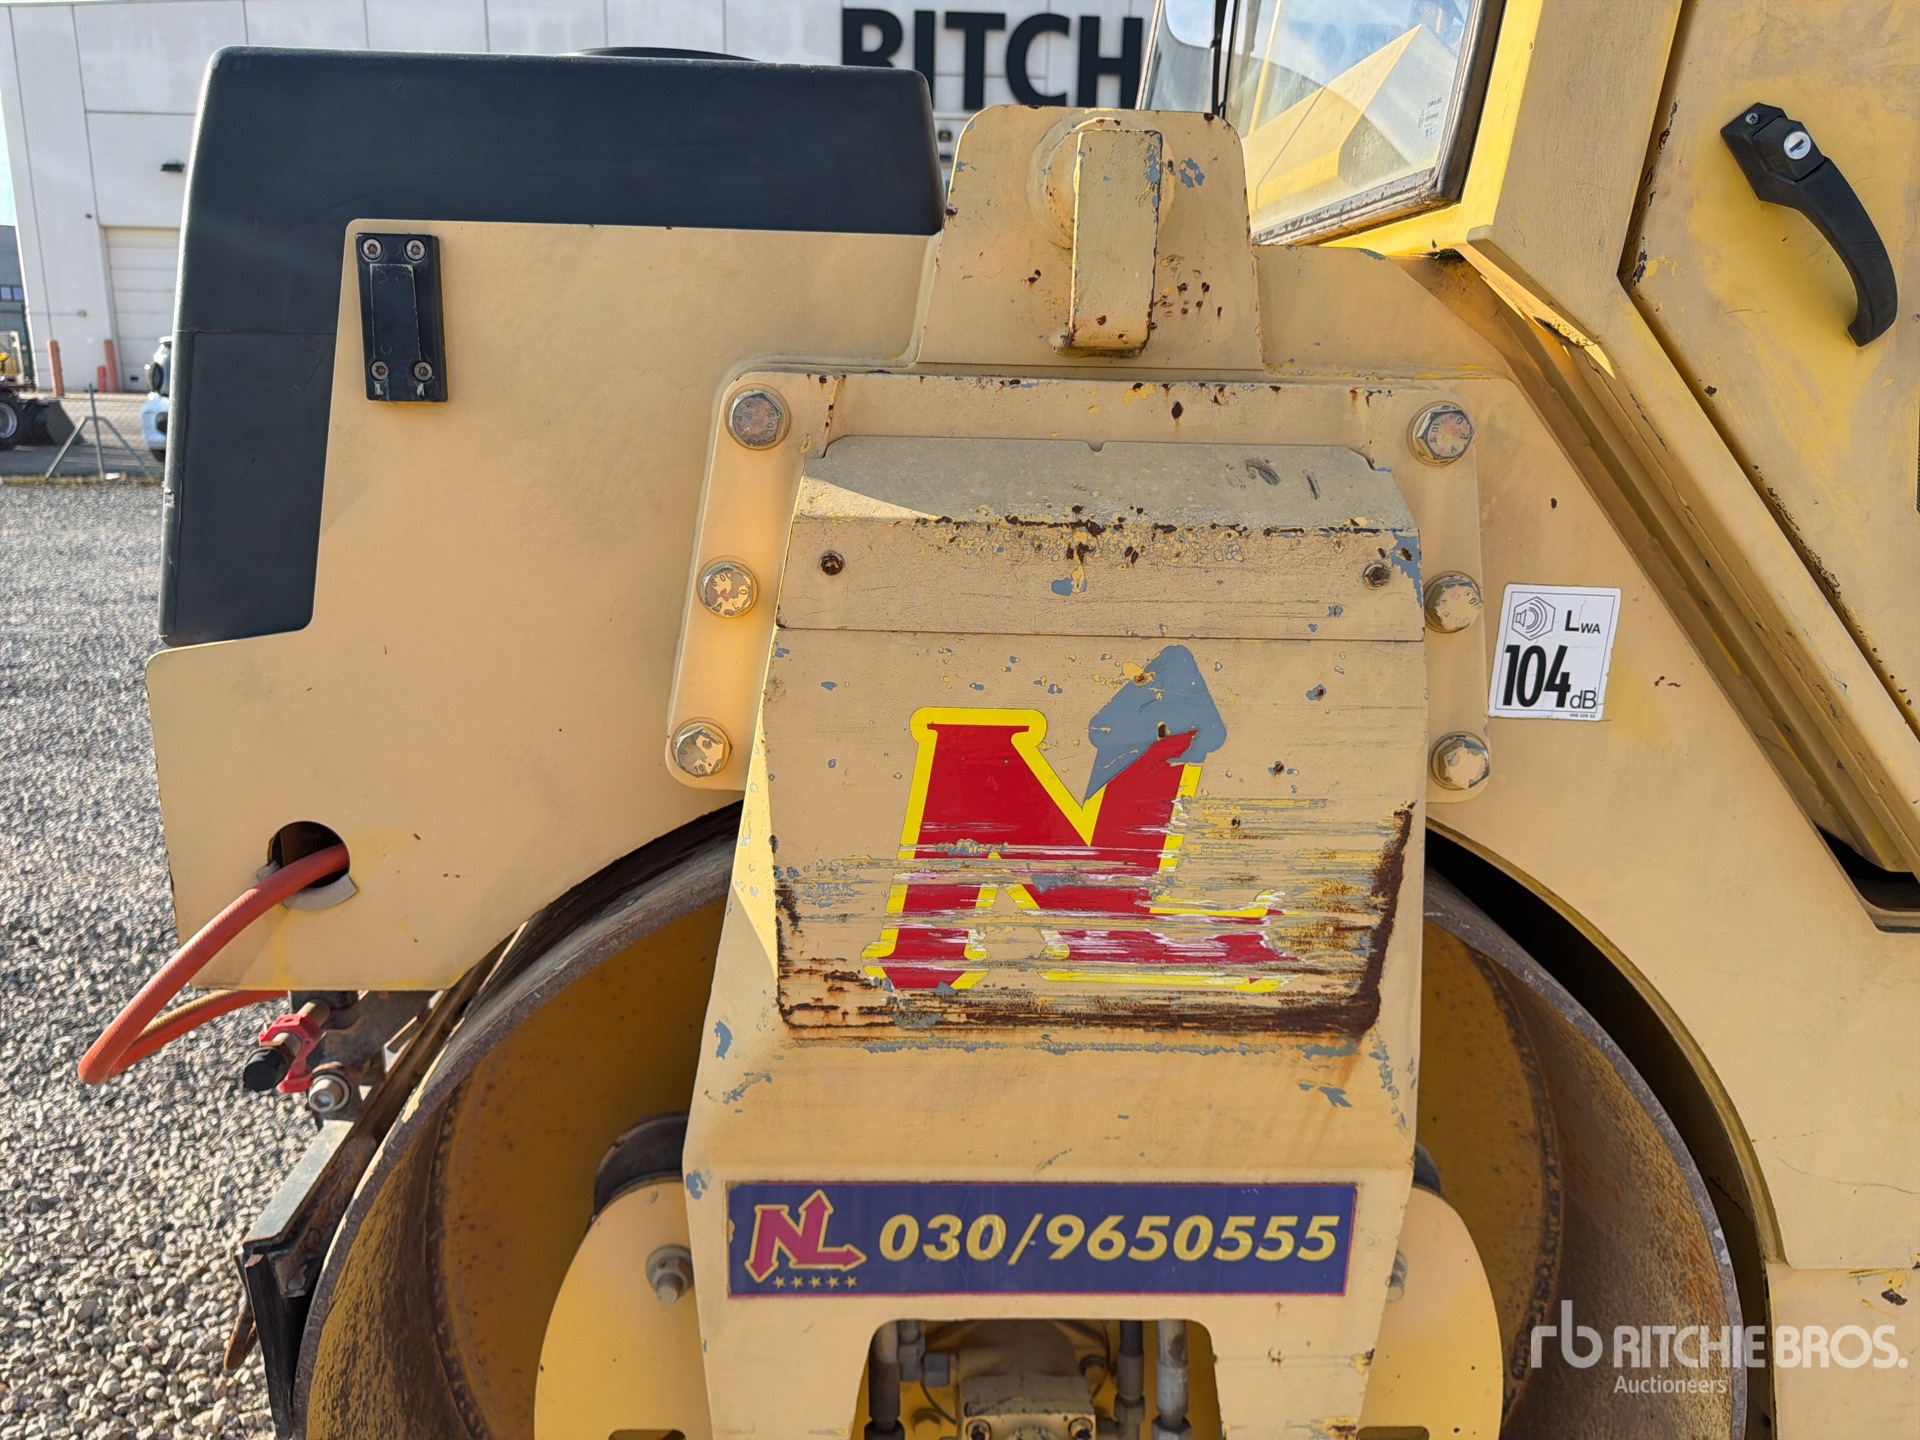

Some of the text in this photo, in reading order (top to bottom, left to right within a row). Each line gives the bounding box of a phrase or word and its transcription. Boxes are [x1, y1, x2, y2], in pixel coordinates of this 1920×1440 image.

[1502, 644, 1597, 709] 104 dB
[878, 1213, 1340, 1266] 030/9650555
